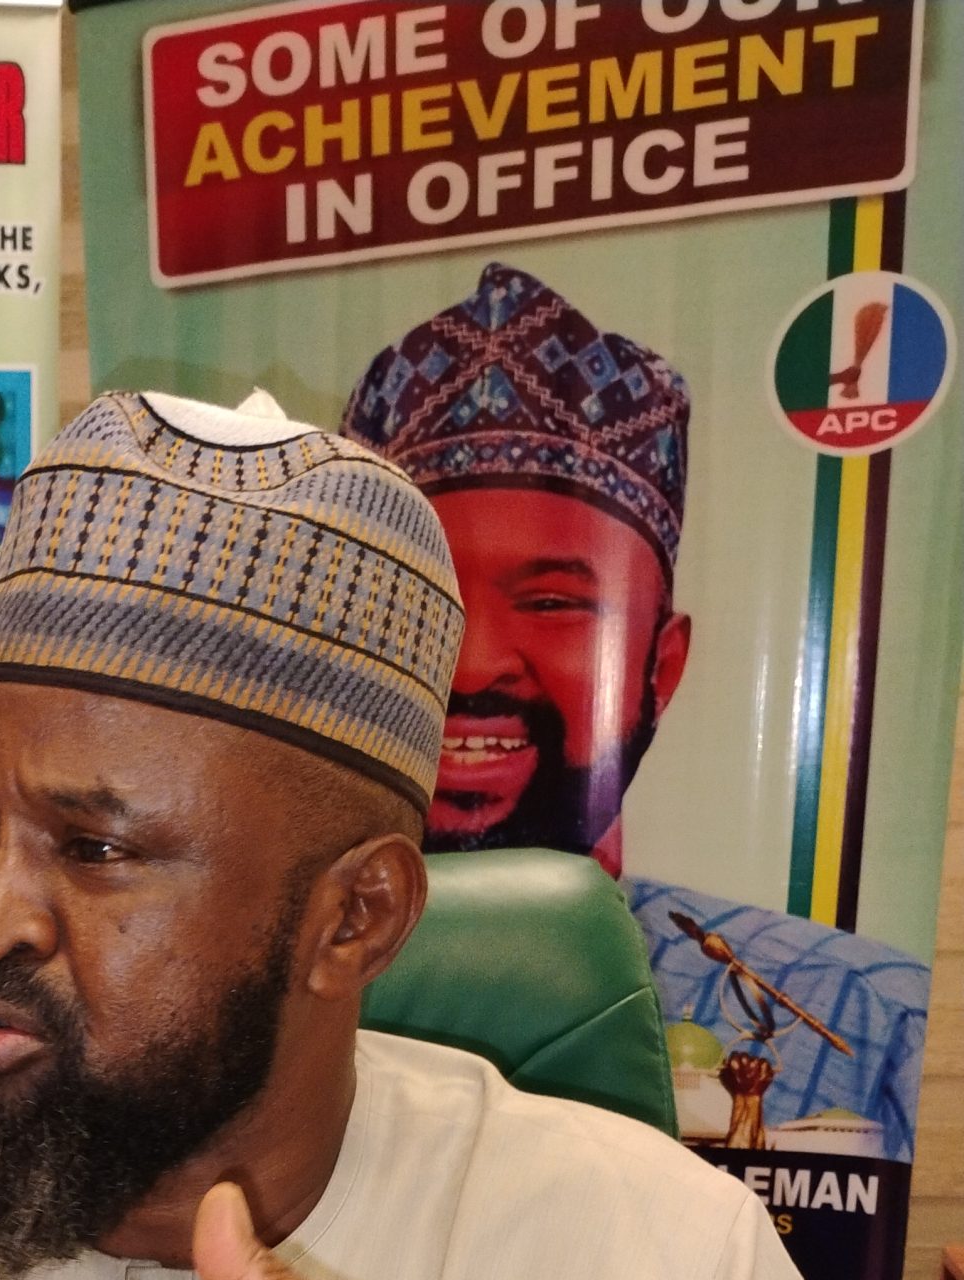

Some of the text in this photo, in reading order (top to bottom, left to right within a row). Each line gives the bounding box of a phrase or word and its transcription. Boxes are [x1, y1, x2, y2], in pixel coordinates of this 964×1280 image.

[186, 17, 879, 188] ACHIEVEMENT
[197, 8, 446, 108] SOME
[482, 0, 601, 59] OF
[284, 117, 751, 246] IN OFFICE
[817, 405, 898, 438] APC
